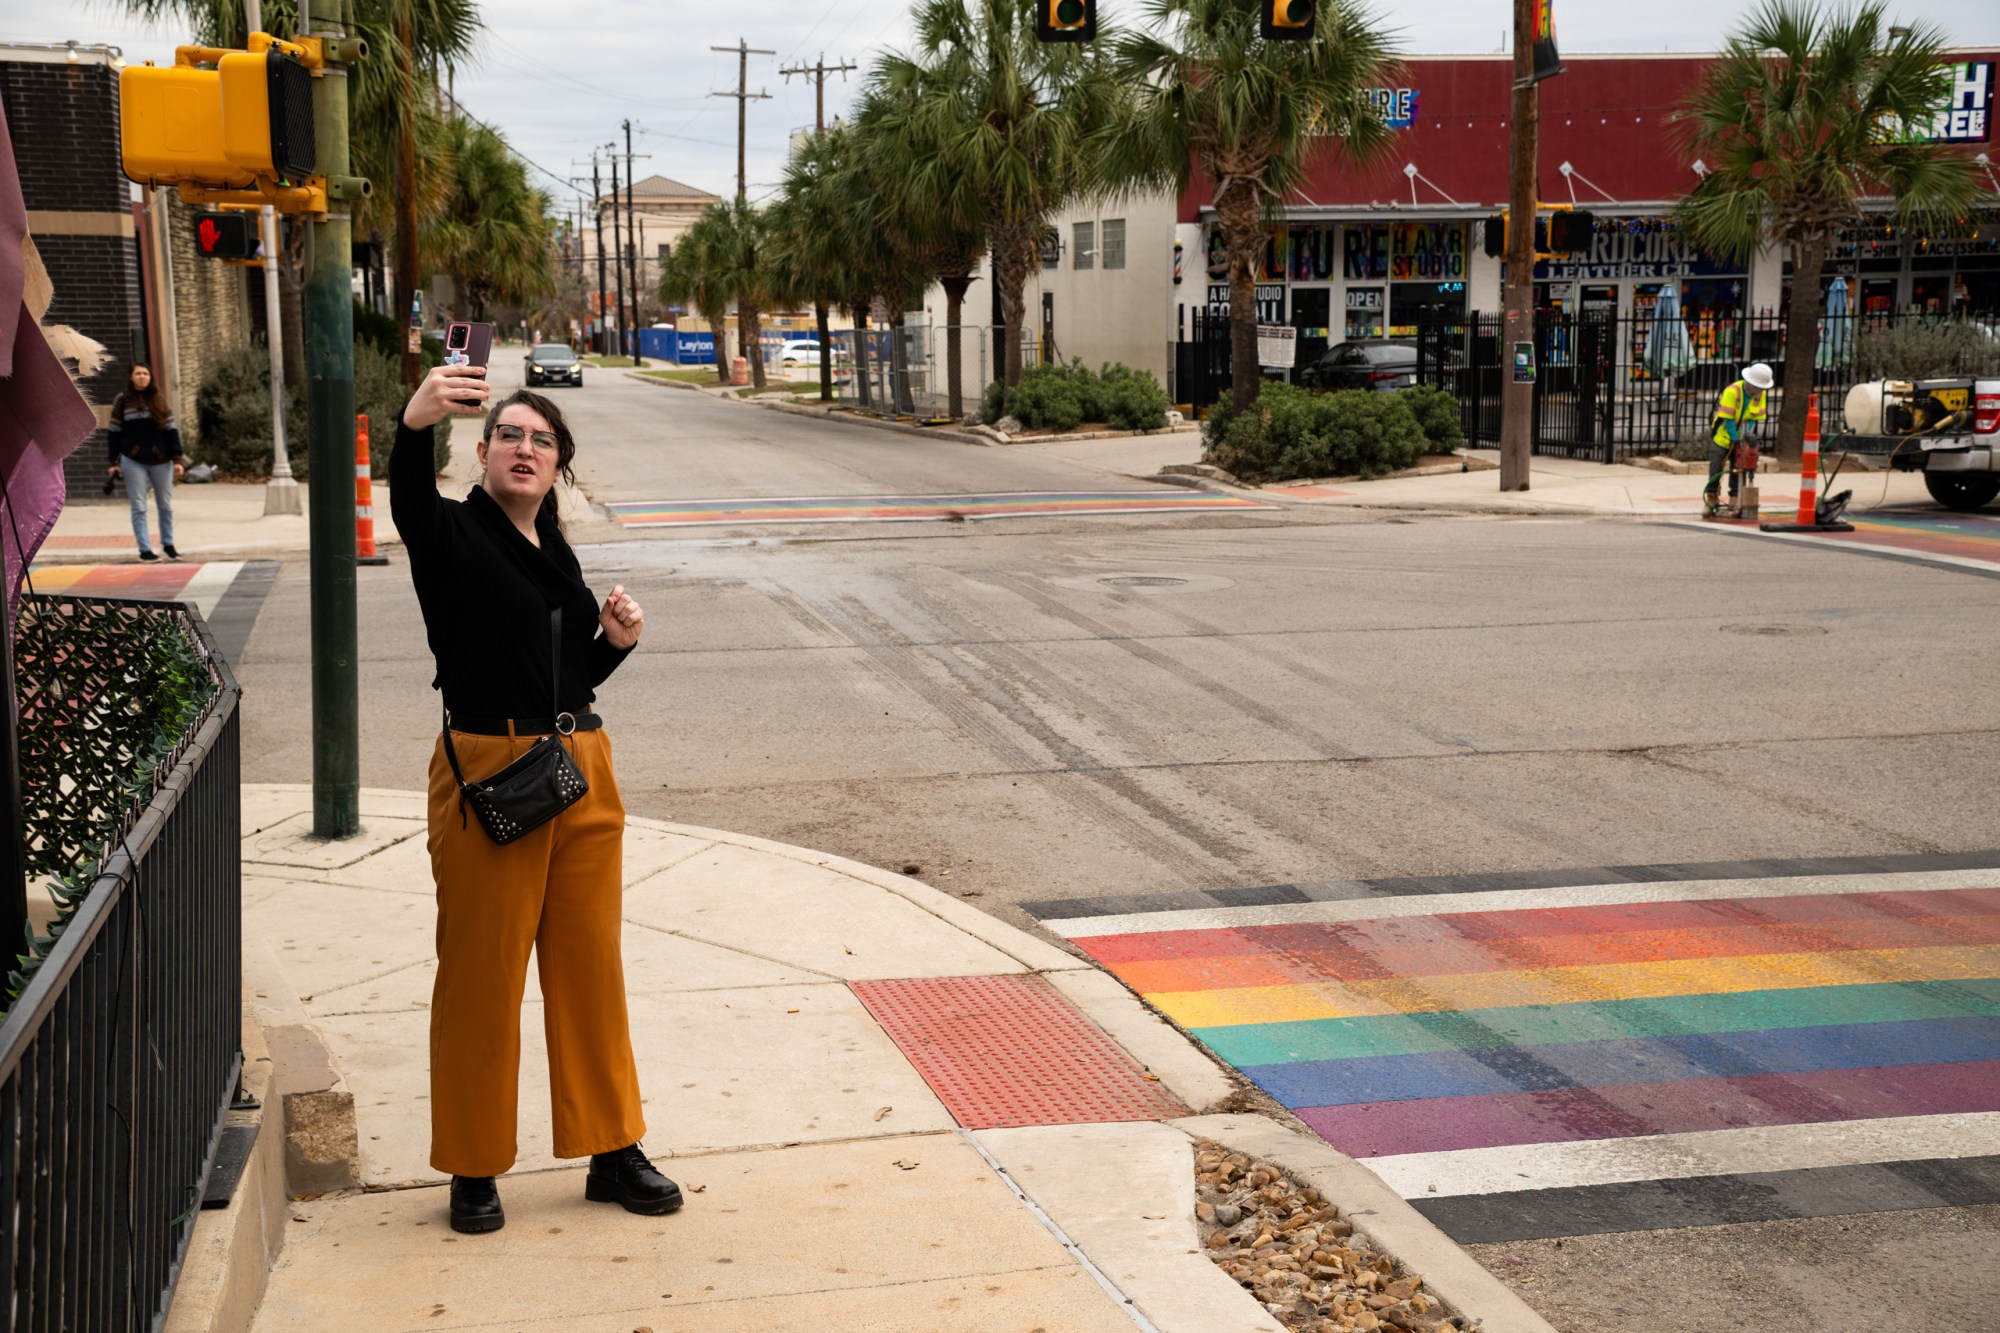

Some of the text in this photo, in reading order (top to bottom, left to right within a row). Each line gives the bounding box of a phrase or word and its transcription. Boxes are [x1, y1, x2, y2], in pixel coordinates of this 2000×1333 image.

[1393, 230, 1462, 254] HAIR
[1393, 254, 1462, 277] STUDIO
[1547, 262, 1696, 279] LEATHER CO.
[1210, 287, 1218, 301] A
[1346, 292, 1383, 307] OPEN
[678, 339, 714, 352] Layton
